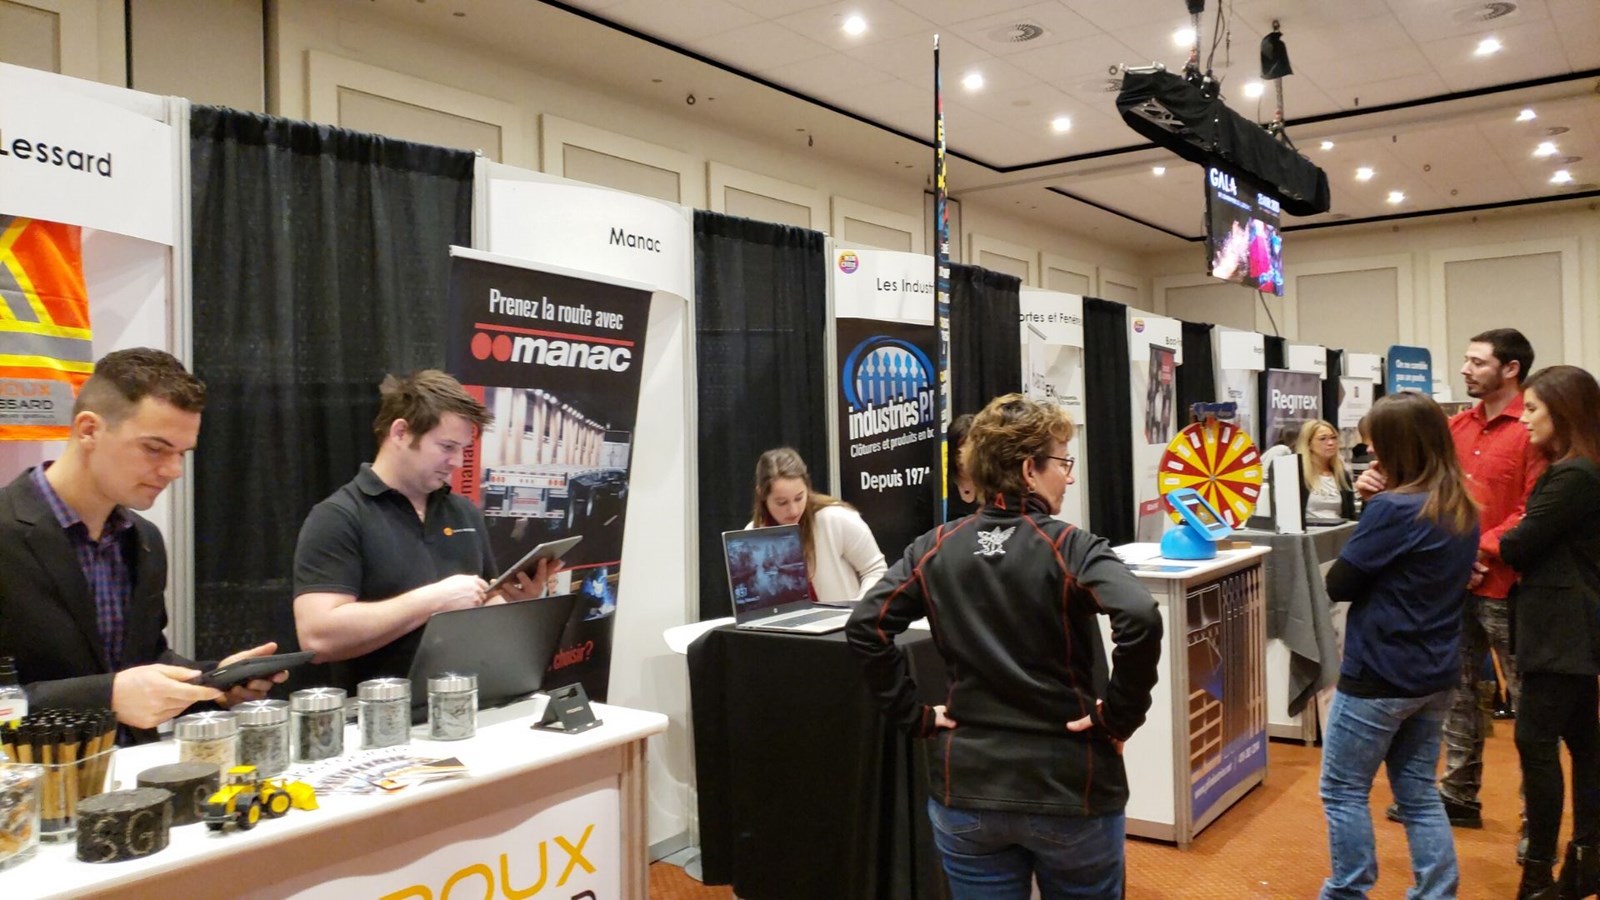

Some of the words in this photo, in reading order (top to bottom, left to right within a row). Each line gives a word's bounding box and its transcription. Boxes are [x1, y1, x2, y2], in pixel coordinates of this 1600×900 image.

[0, 128, 112, 178] Lessard
[1210, 166, 1238, 196] GALA
[608, 227, 661, 253] Manac
[876, 277, 898, 292] Les
[489, 288, 538, 319] Prenez
[541, 296, 555, 321] la
[557, 303, 593, 326] route
[595, 310, 624, 331] avec
[1047, 311, 1058, 323] et
[510, 335, 632, 373] manac
[848, 396, 919, 440] industries
[850, 441, 882, 458] Clôtures
[882, 438, 890, 450] et
[890, 431, 918, 451] produits
[918, 430, 927, 441] en
[860, 468, 904, 493] Depuis
